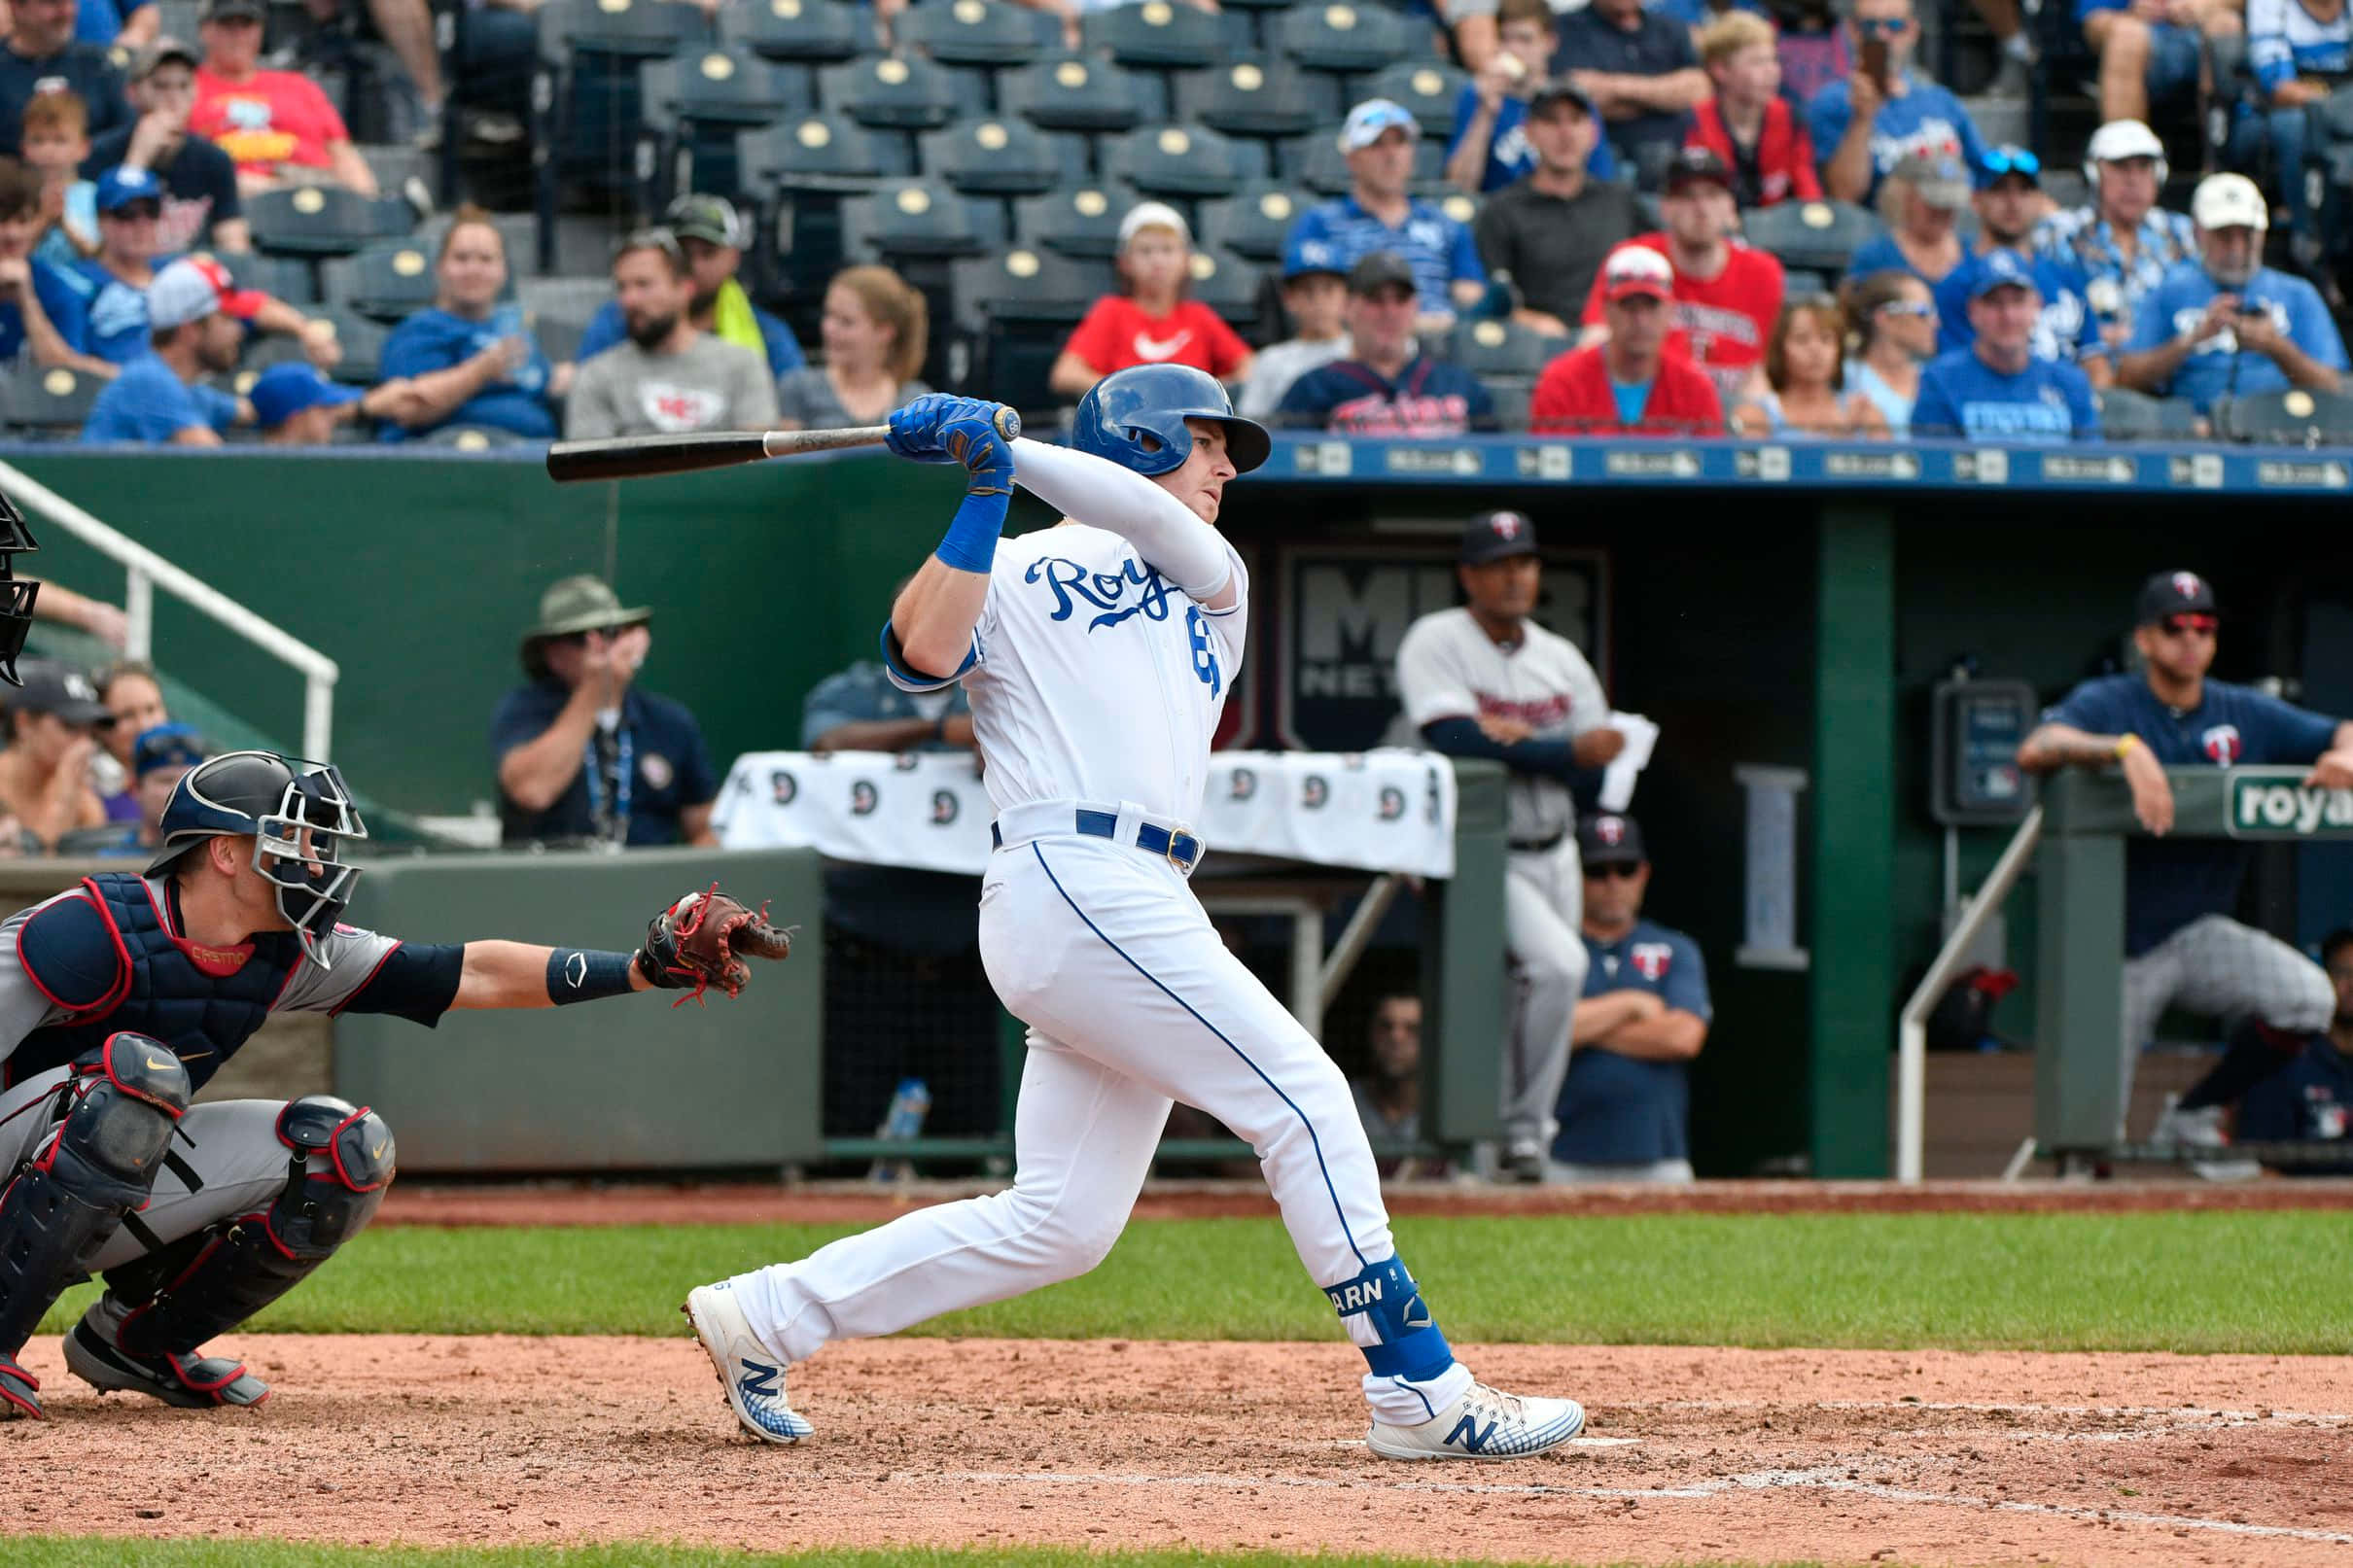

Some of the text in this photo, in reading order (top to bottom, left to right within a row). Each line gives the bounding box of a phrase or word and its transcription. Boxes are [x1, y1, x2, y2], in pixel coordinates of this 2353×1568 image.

[1330, 1277, 1383, 1312] ARN
[740, 1357, 779, 1397] N
[1442, 1414, 1498, 1453] N
